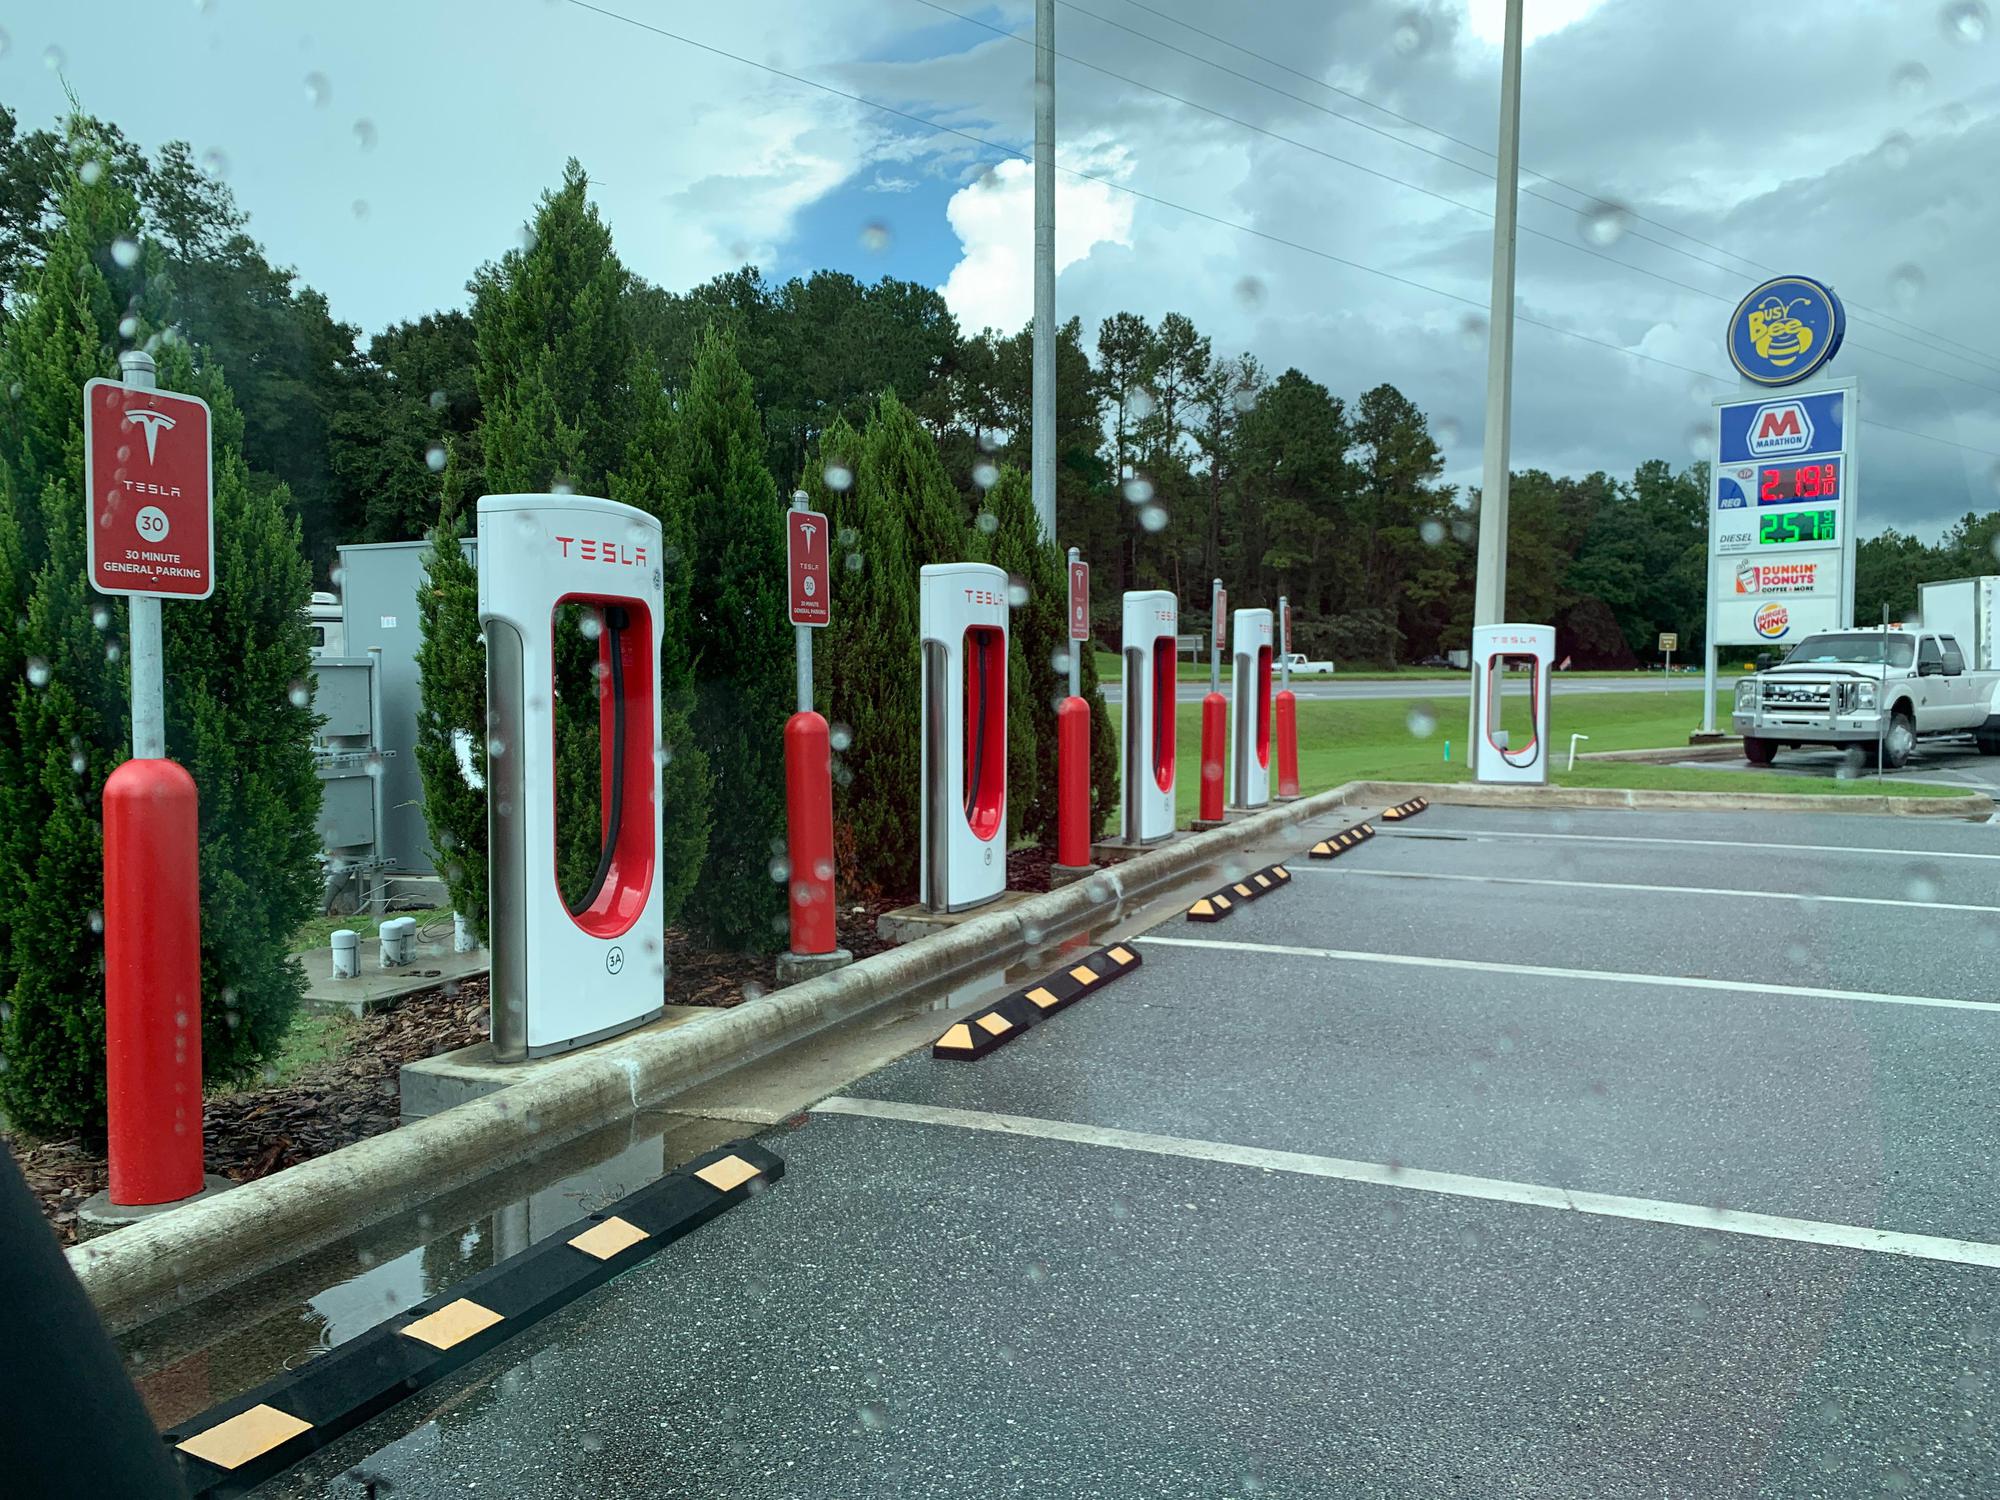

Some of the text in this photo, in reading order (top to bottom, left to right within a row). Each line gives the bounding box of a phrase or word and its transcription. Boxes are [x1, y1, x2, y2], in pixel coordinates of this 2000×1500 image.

[1758, 410, 1801, 439] M
[1756, 436, 1802, 449] MARATHON
[123, 480, 181, 497] TESLA
[1720, 498, 1741, 508] REG
[141, 515, 164, 533] 30
[1720, 533, 1752, 543] DIESEL
[125, 549, 182, 564] 30 MINUTE
[555, 536, 647, 568] TESLA
[103, 561, 202, 579] GENERAL PARKING
[1762, 564, 1818, 576] DUNKIN'
[1762, 574, 1815, 586] DONUTS
[1761, 586, 1788, 594] COFFEE
[1757, 608, 1788, 621] BURGER
[1759, 615, 1789, 631] KING
[1491, 636, 1537, 645] TESLA
[609, 953, 622, 967] 3A
